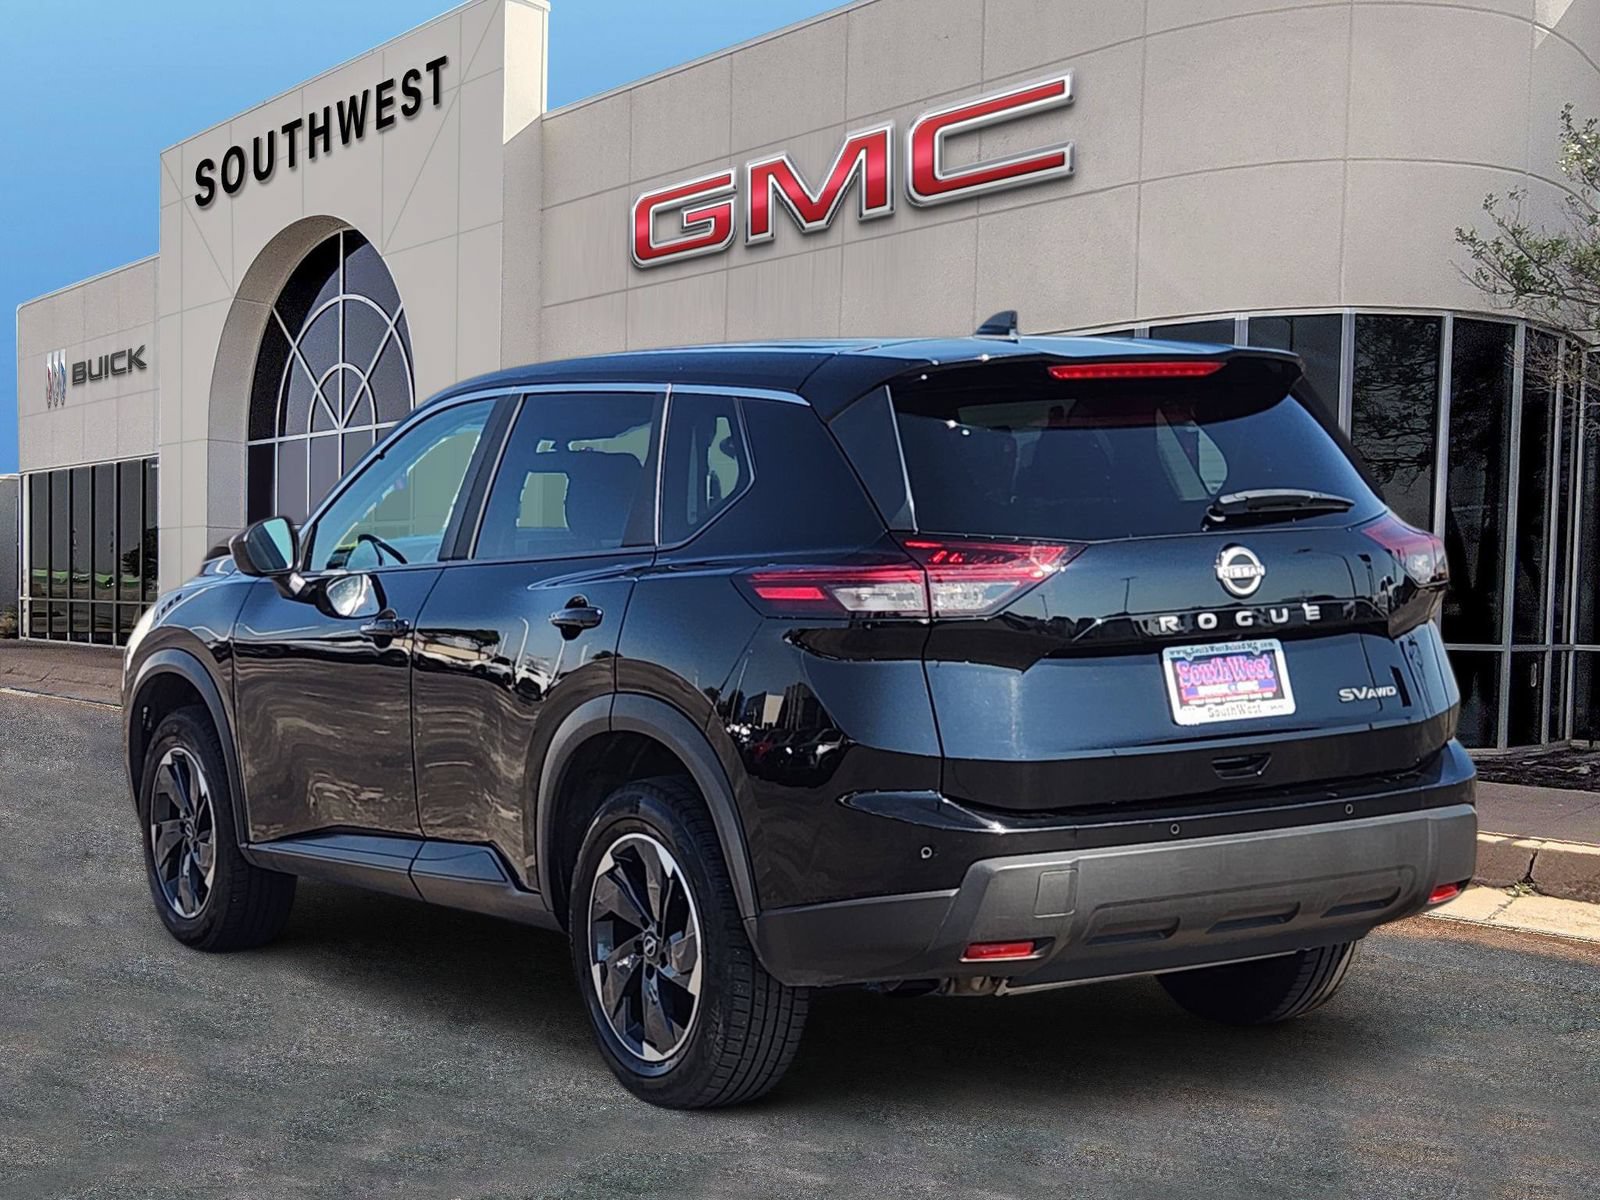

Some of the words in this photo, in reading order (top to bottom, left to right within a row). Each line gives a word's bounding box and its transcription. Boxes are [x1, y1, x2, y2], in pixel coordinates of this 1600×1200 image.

[194, 55, 449, 207] SOUTHWEST
[630, 69, 1075, 268] GMC
[72, 344, 147, 386] BUICK
[1158, 603, 1322, 632] ROGUE
